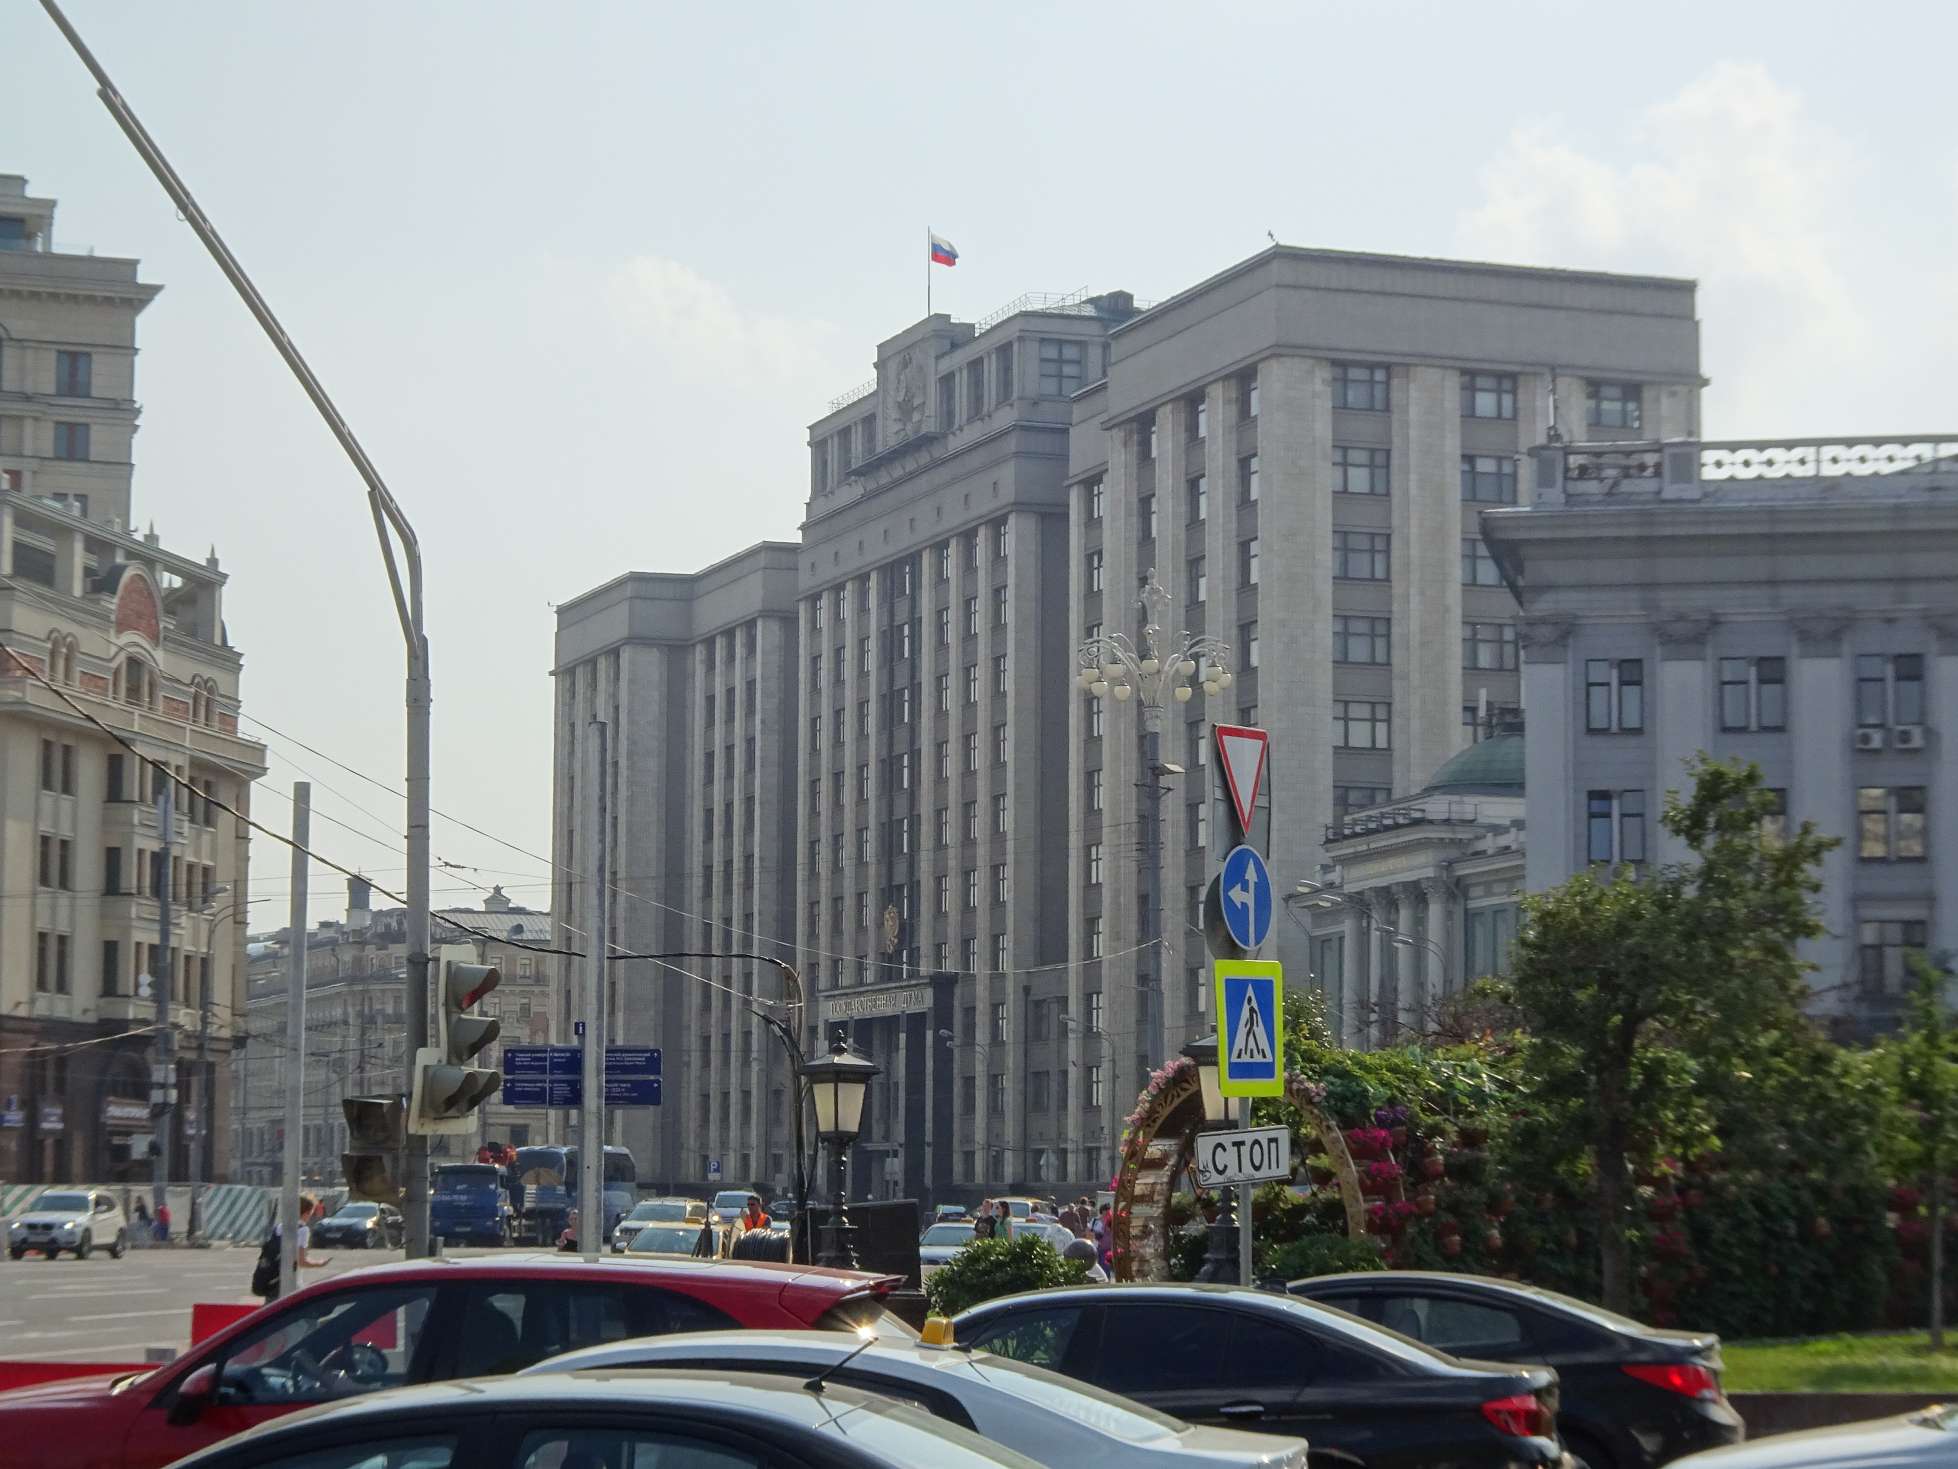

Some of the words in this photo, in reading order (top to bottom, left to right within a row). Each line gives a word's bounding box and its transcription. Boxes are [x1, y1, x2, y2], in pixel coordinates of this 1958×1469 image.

[831, 994, 895, 1015] ГОСУДАРСТВЕННАЯ
[902, 991, 924, 1008] ДУМА
[710, 1161, 718, 1174] P
[1212, 1138, 1279, 1175] СТОП
